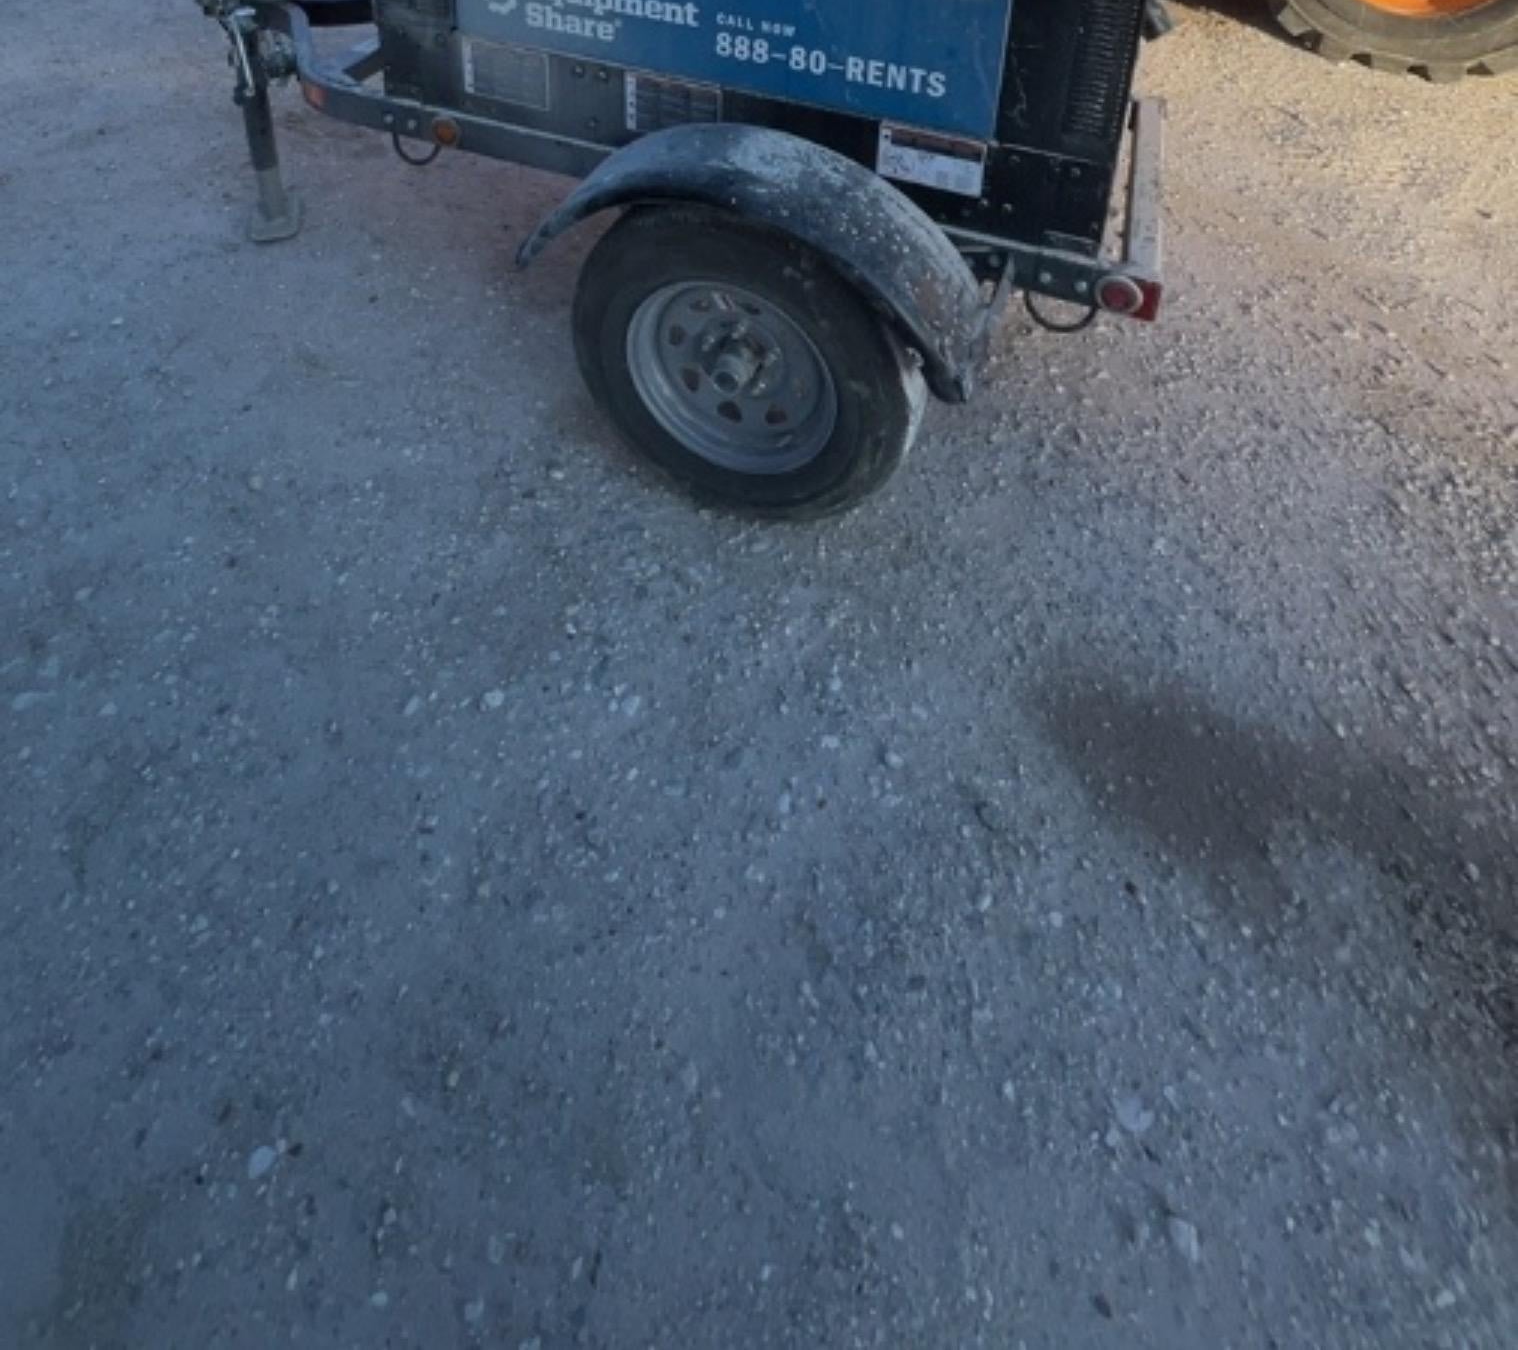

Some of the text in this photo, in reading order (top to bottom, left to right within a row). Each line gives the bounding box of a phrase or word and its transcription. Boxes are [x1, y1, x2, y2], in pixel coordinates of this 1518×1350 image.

[525, 2, 617, 41] Share
[716, 11, 796, 38] CALL NOW
[716, 31, 947, 98] 888-80-RENTS
